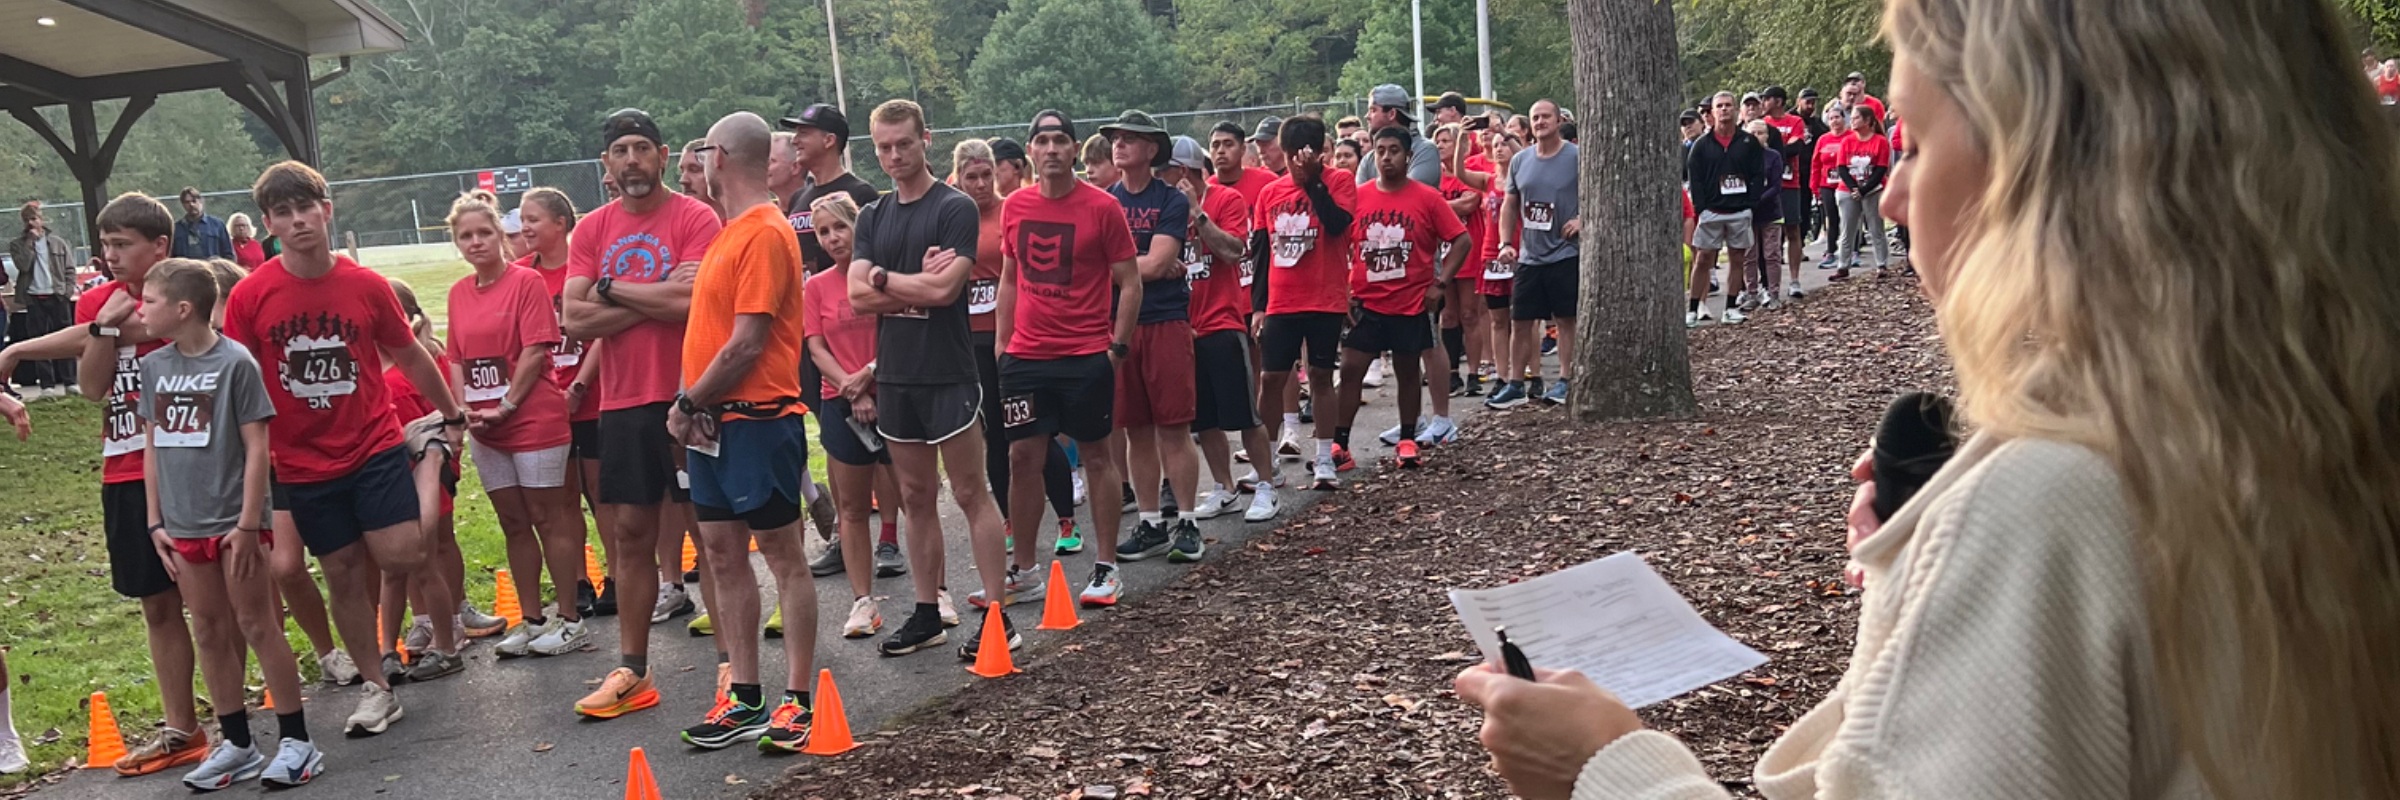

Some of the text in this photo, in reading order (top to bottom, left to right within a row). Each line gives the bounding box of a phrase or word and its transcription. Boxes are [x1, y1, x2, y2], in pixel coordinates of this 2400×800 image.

[1530, 207, 1548, 222] 786
[1283, 243, 1306, 258] 791
[1373, 254, 1396, 272] 794
[971, 284, 995, 304] 738
[303, 357, 341, 382] 426
[471, 366, 499, 388] 500
[156, 371, 220, 392] NIKE
[308, 396, 332, 409] 5K
[1004, 400, 1029, 423] 733
[109, 411, 136, 440] 740
[166, 405, 199, 430] 974
